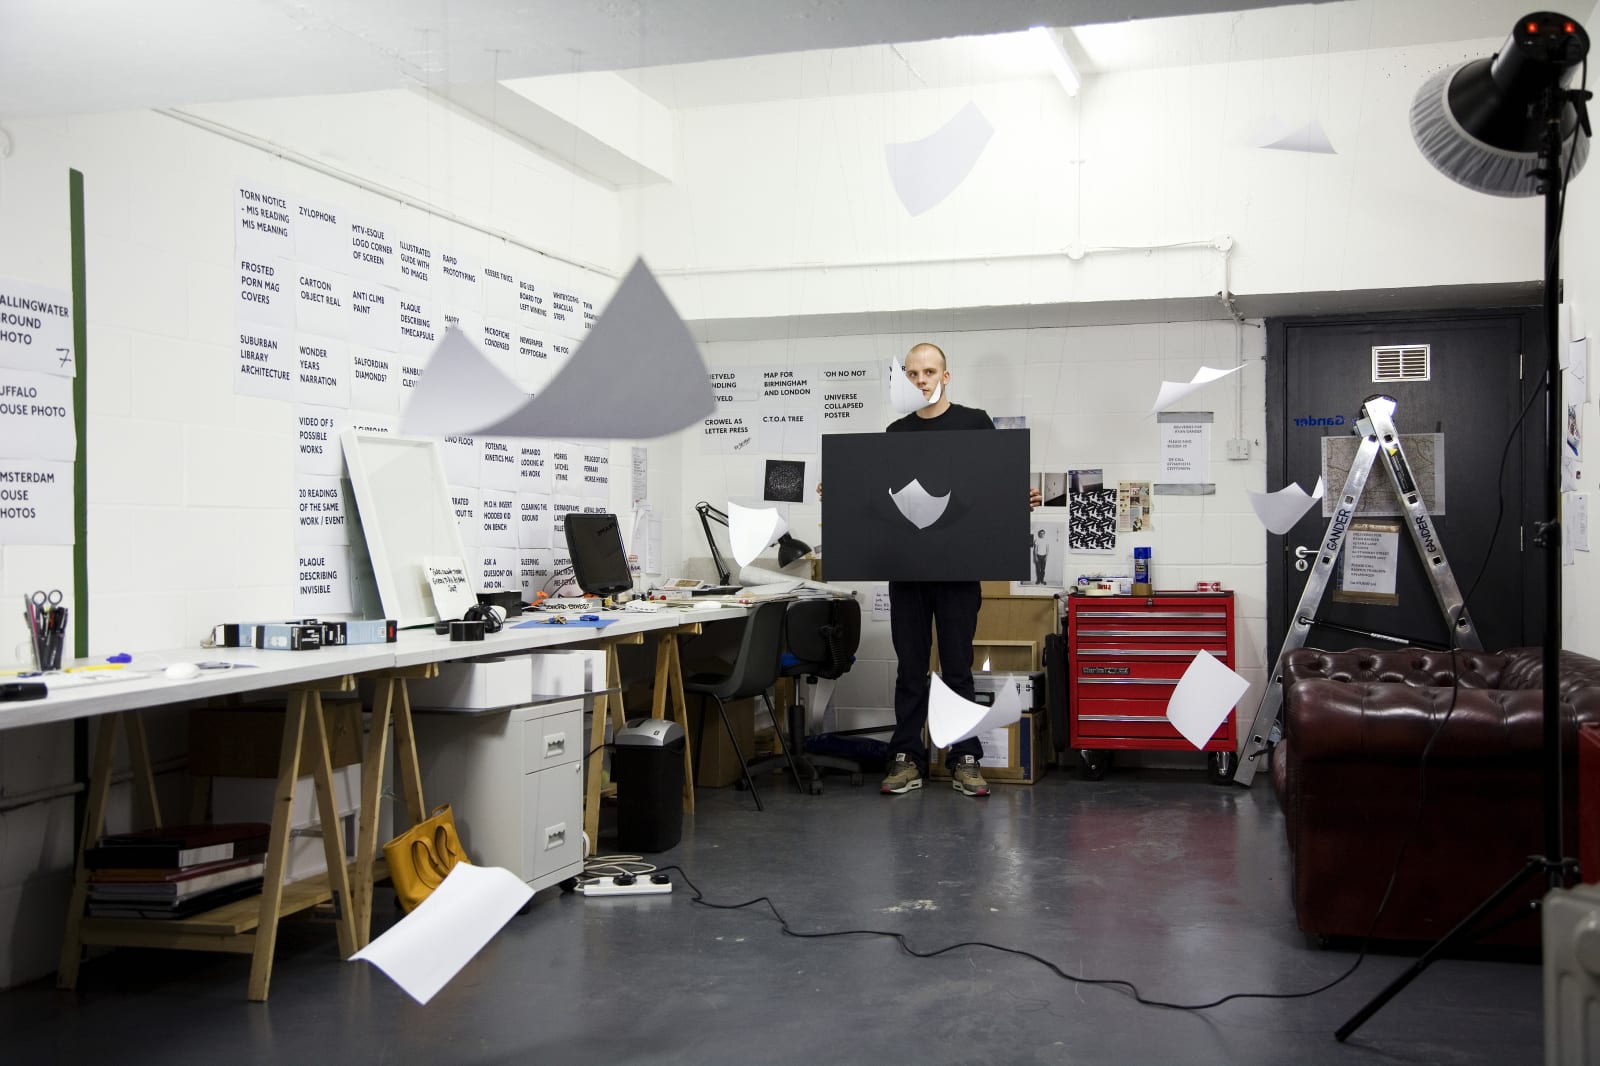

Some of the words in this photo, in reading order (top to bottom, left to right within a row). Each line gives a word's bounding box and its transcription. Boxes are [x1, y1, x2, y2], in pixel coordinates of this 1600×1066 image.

[240, 189, 260, 203] TORN
[262, 196, 287, 209] NOTICE
[246, 205, 259, 216] MIS
[260, 209, 290, 224] READING
[299, 206, 337, 225] ZYLOPHONE
[242, 219, 255, 230] MIS
[257, 223, 288, 237] MEANING
[352, 224, 385, 240] MTV-ESQUE
[352, 237, 369, 249] LOGO
[370, 241, 393, 255] CORNER
[400, 241, 431, 259] ILLUSTRATED
[352, 250, 361, 260] OF
[362, 252, 385, 266] SCREEN
[400, 253, 416, 267] GUIDE
[417, 257, 430, 270] WITH
[442, 254, 458, 265] RAPID
[241, 261, 274, 276] FROSTED
[401, 265, 410, 275] NO
[410, 268, 428, 282] IMAGES
[443, 266, 476, 283] PROTOTYPING
[500, 271, 513, 283] TWICE
[241, 276, 262, 289] PORN
[264, 280, 280, 293] MAG
[299, 276, 332, 291] CARTOON
[241, 290, 270, 305] COVERS
[300, 291, 324, 304] OBJECT
[325, 294, 341, 307] REAL
[352, 290, 367, 301] ANTI
[368, 293, 385, 305] CLIMB
[520, 292, 534, 303] BOARD
[353, 304, 370, 315] PAINT
[400, 301, 421, 313] PLAQUE
[520, 303, 529, 311] LEFT
[1, 312, 41, 329] ROUND
[400, 314, 430, 328] DESCRIBING
[0, 330, 32, 345] HOTO
[401, 327, 435, 341] TIMECAPSULE
[485, 326, 510, 340] MICROFICHE
[240, 334, 278, 350] SUBURBAN
[485, 338, 510, 351] CONDENSED
[520, 336, 543, 348] NEWSPAPER
[240, 350, 269, 362] LIBRARY
[299, 346, 327, 358] WONDER
[520, 347, 547, 359] CRYPTOGRAM
[561, 346, 569, 354] FOG
[56, 347, 72, 368] 7
[354, 356, 389, 370] SALFORDIAN
[300, 359, 320, 371] YEARS
[241, 364, 290, 380] ARCHITECTURE
[355, 370, 387, 382] DIAMONDS?
[300, 374, 337, 387] NARRATION
[780, 388, 811, 396] LONDON
[0, 403, 28, 415] OUSE
[31, 405, 66, 417] PHOTO
[824, 402, 864, 410] COLLAPSED
[824, 411, 850, 419] POSTER
[299, 417, 319, 427] VIDEO
[320, 418, 329, 427] OF
[330, 419, 334, 428] 5
[704, 418, 732, 426] CROWEL
[300, 431, 327, 441] POSSIBLE
[705, 427, 728, 435] LETTER
[729, 426, 749, 434] PRESS
[458, 436, 473, 446] FLOOR
[485, 442, 508, 451] POTENTIAL
[300, 445, 323, 454] WORKS
[485, 453, 504, 462] KINETICS
[504, 455, 514, 463] MAG
[0, 471, 55, 483] MSTERDAM
[0, 489, 29, 501] OUSE
[299, 489, 307, 498] 20
[308, 489, 337, 498] READINGS
[0, 507, 36, 519] HOTOS
[300, 503, 308, 511] OF
[310, 503, 321, 511] THE
[322, 503, 339, 511] SAME
[300, 517, 319, 525] WORK
[325, 516, 344, 525] EVENT
[1327, 508, 1351, 551] GANDER
[1416, 515, 1436, 552] GANDER
[300, 557, 325, 567] PLAQUE
[300, 571, 337, 580] DESCRIBING
[300, 585, 331, 594] INVISIBLE
